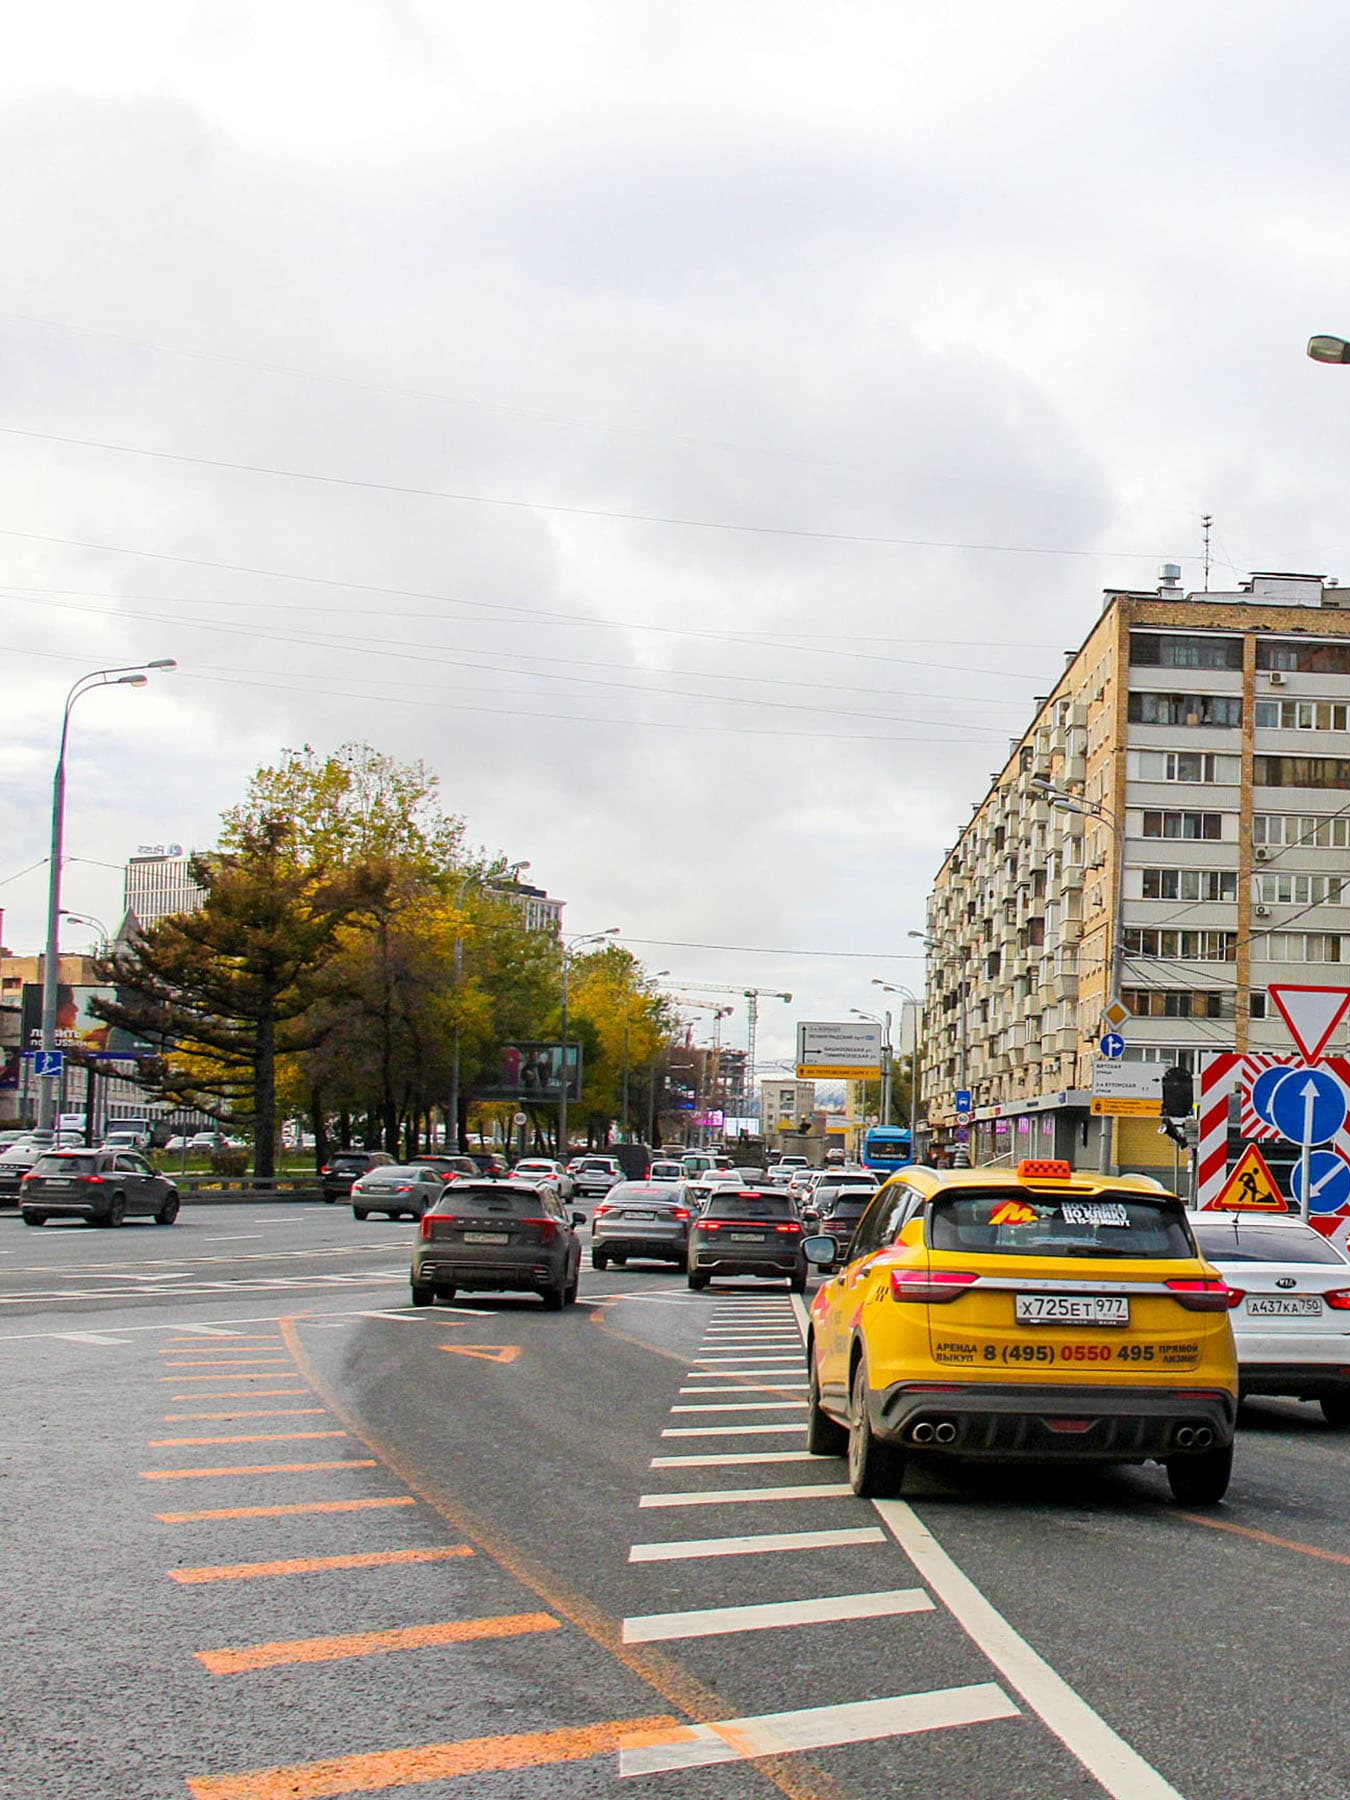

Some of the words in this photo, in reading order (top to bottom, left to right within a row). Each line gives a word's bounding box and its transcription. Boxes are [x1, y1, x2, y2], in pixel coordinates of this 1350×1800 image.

[1063, 1208, 1080, 1220] ПО
[1096, 1299, 1123, 1312] 977
[1300, 1300, 1319, 1310] 750
[936, 1343, 977, 1353] АРЕНДА
[1159, 1342, 1198, 1353] ПРЯМОЙ
[936, 1353, 973, 1362] ВЫКУП
[984, 1345, 996, 1360] 8
[1002, 1345, 1055, 1364] (495)
[1061, 1345, 1112, 1361] 0550
[1117, 1345, 1155, 1361] 495
